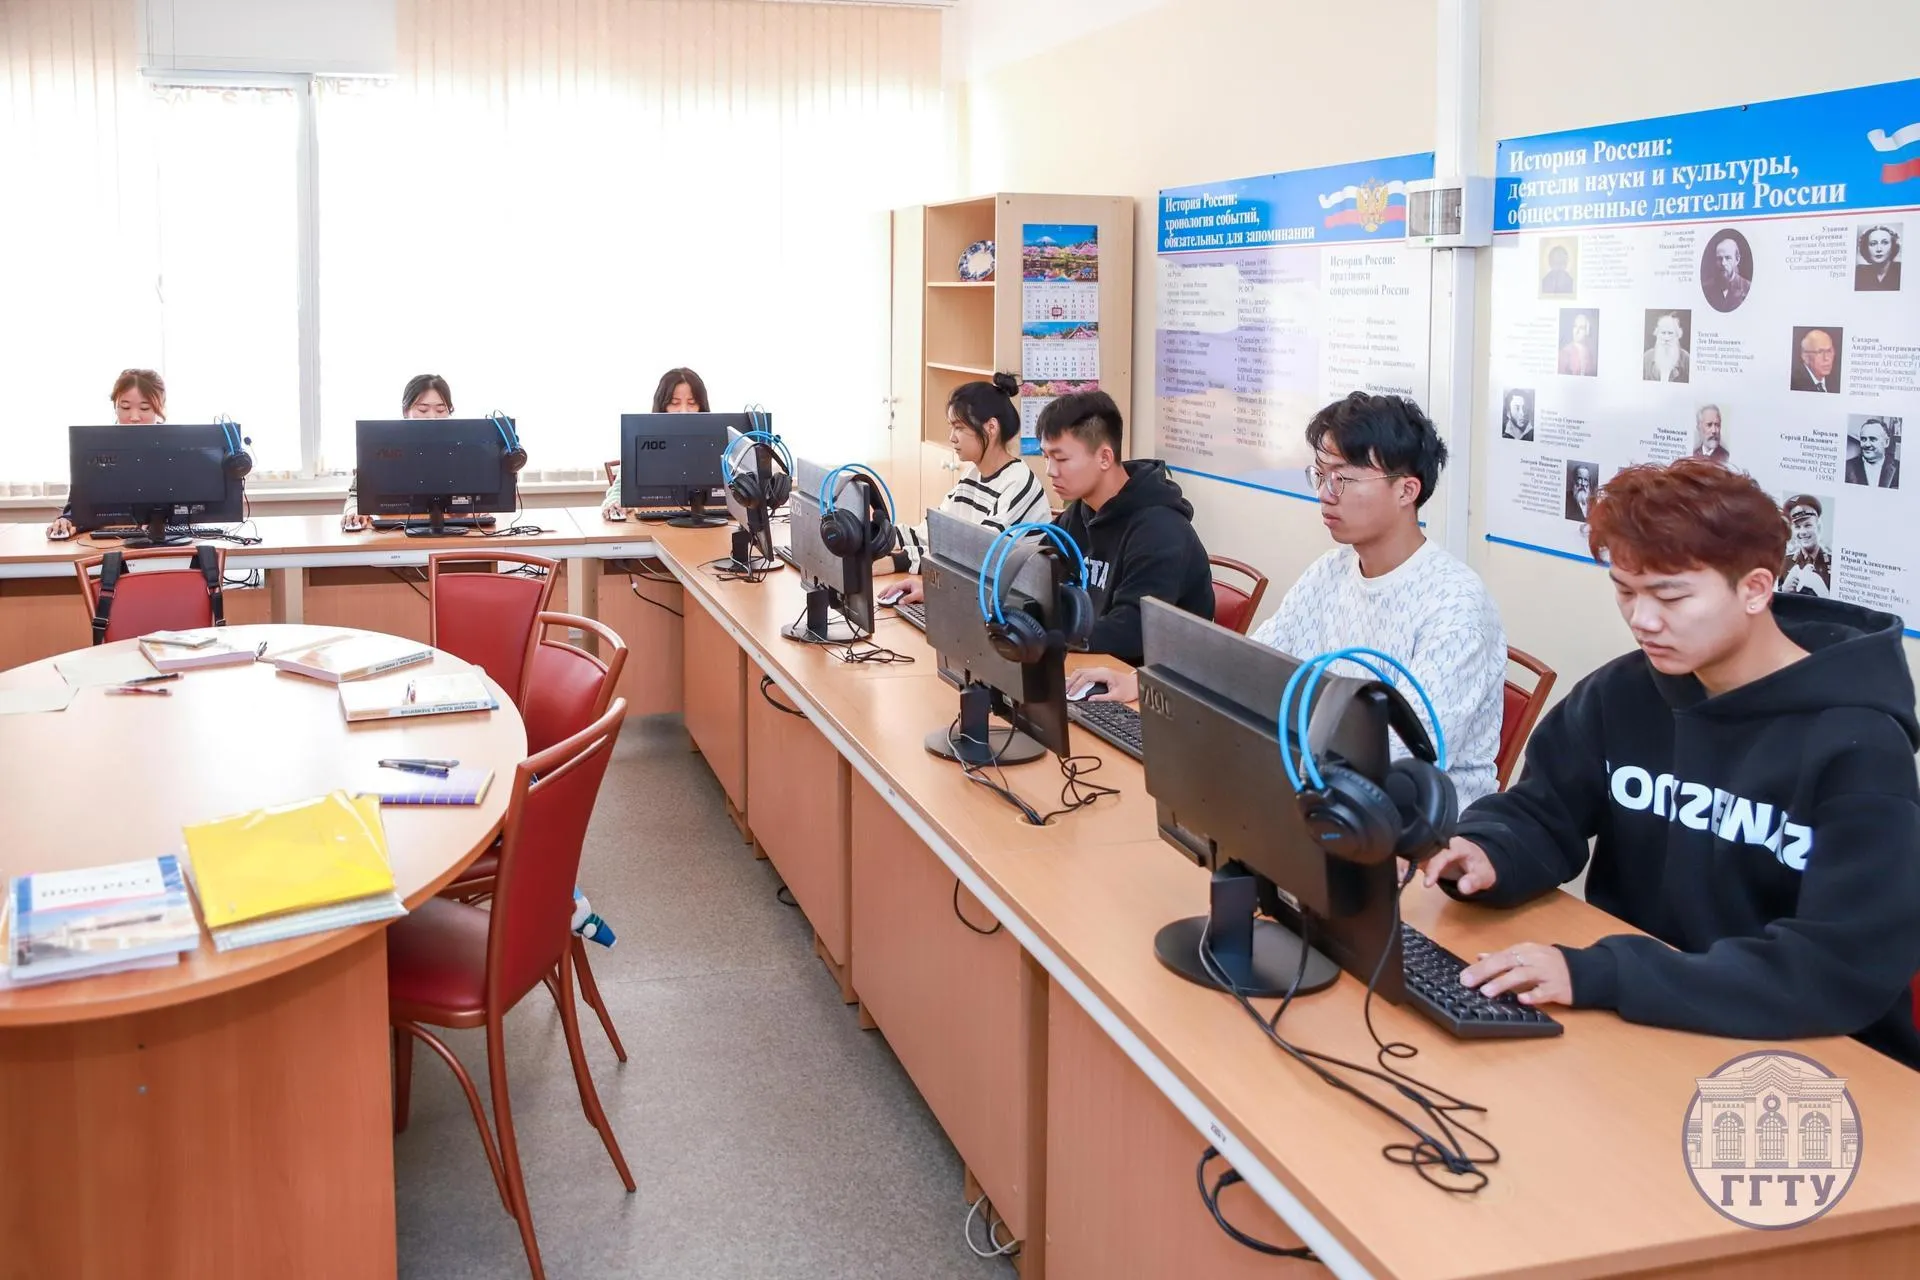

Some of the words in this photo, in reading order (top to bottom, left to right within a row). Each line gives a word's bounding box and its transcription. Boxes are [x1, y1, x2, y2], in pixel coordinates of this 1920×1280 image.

[1509, 146, 1587, 174] История
[1593, 136, 1673, 164] России:
[1508, 173, 1579, 201] деятели
[1585, 168, 1645, 197] науки
[1652, 167, 1666, 186] и
[1671, 155, 1800, 187] культуры,
[1165, 196, 1201, 214] История
[1203, 192, 1238, 207] России:
[1508, 197, 1648, 226] общественные
[1651, 185, 1746, 220] деятели
[1753, 183, 1846, 209] России
[1165, 212, 1214, 231] хронология
[1216, 207, 1260, 226] событий,
[1164, 230, 1224, 249] обязательных
[1225, 231, 1244, 245] для
[1246, 227, 1316, 243] запоминания
[1330, 255, 1362, 270] История
[1365, 255, 1395, 265] России:
[1381, 284, 1409, 296] России
[1852, 336, 1879, 344] Сахаров
[1780, 433, 1801, 441] Сергей
[1803, 436, 1833, 444] Павлович
[641, 441, 666, 450] AOC
[1800, 443, 1837, 452] Генеральный
[1841, 547, 1867, 558] Гагарин
[1840, 564, 1862, 572] первый
[1841, 555, 1861, 564] Юрий
[1864, 560, 1901, 572] Алексеевич
[1840, 577, 1870, 589] Совершил
[1890, 593, 1904, 604] 1961
